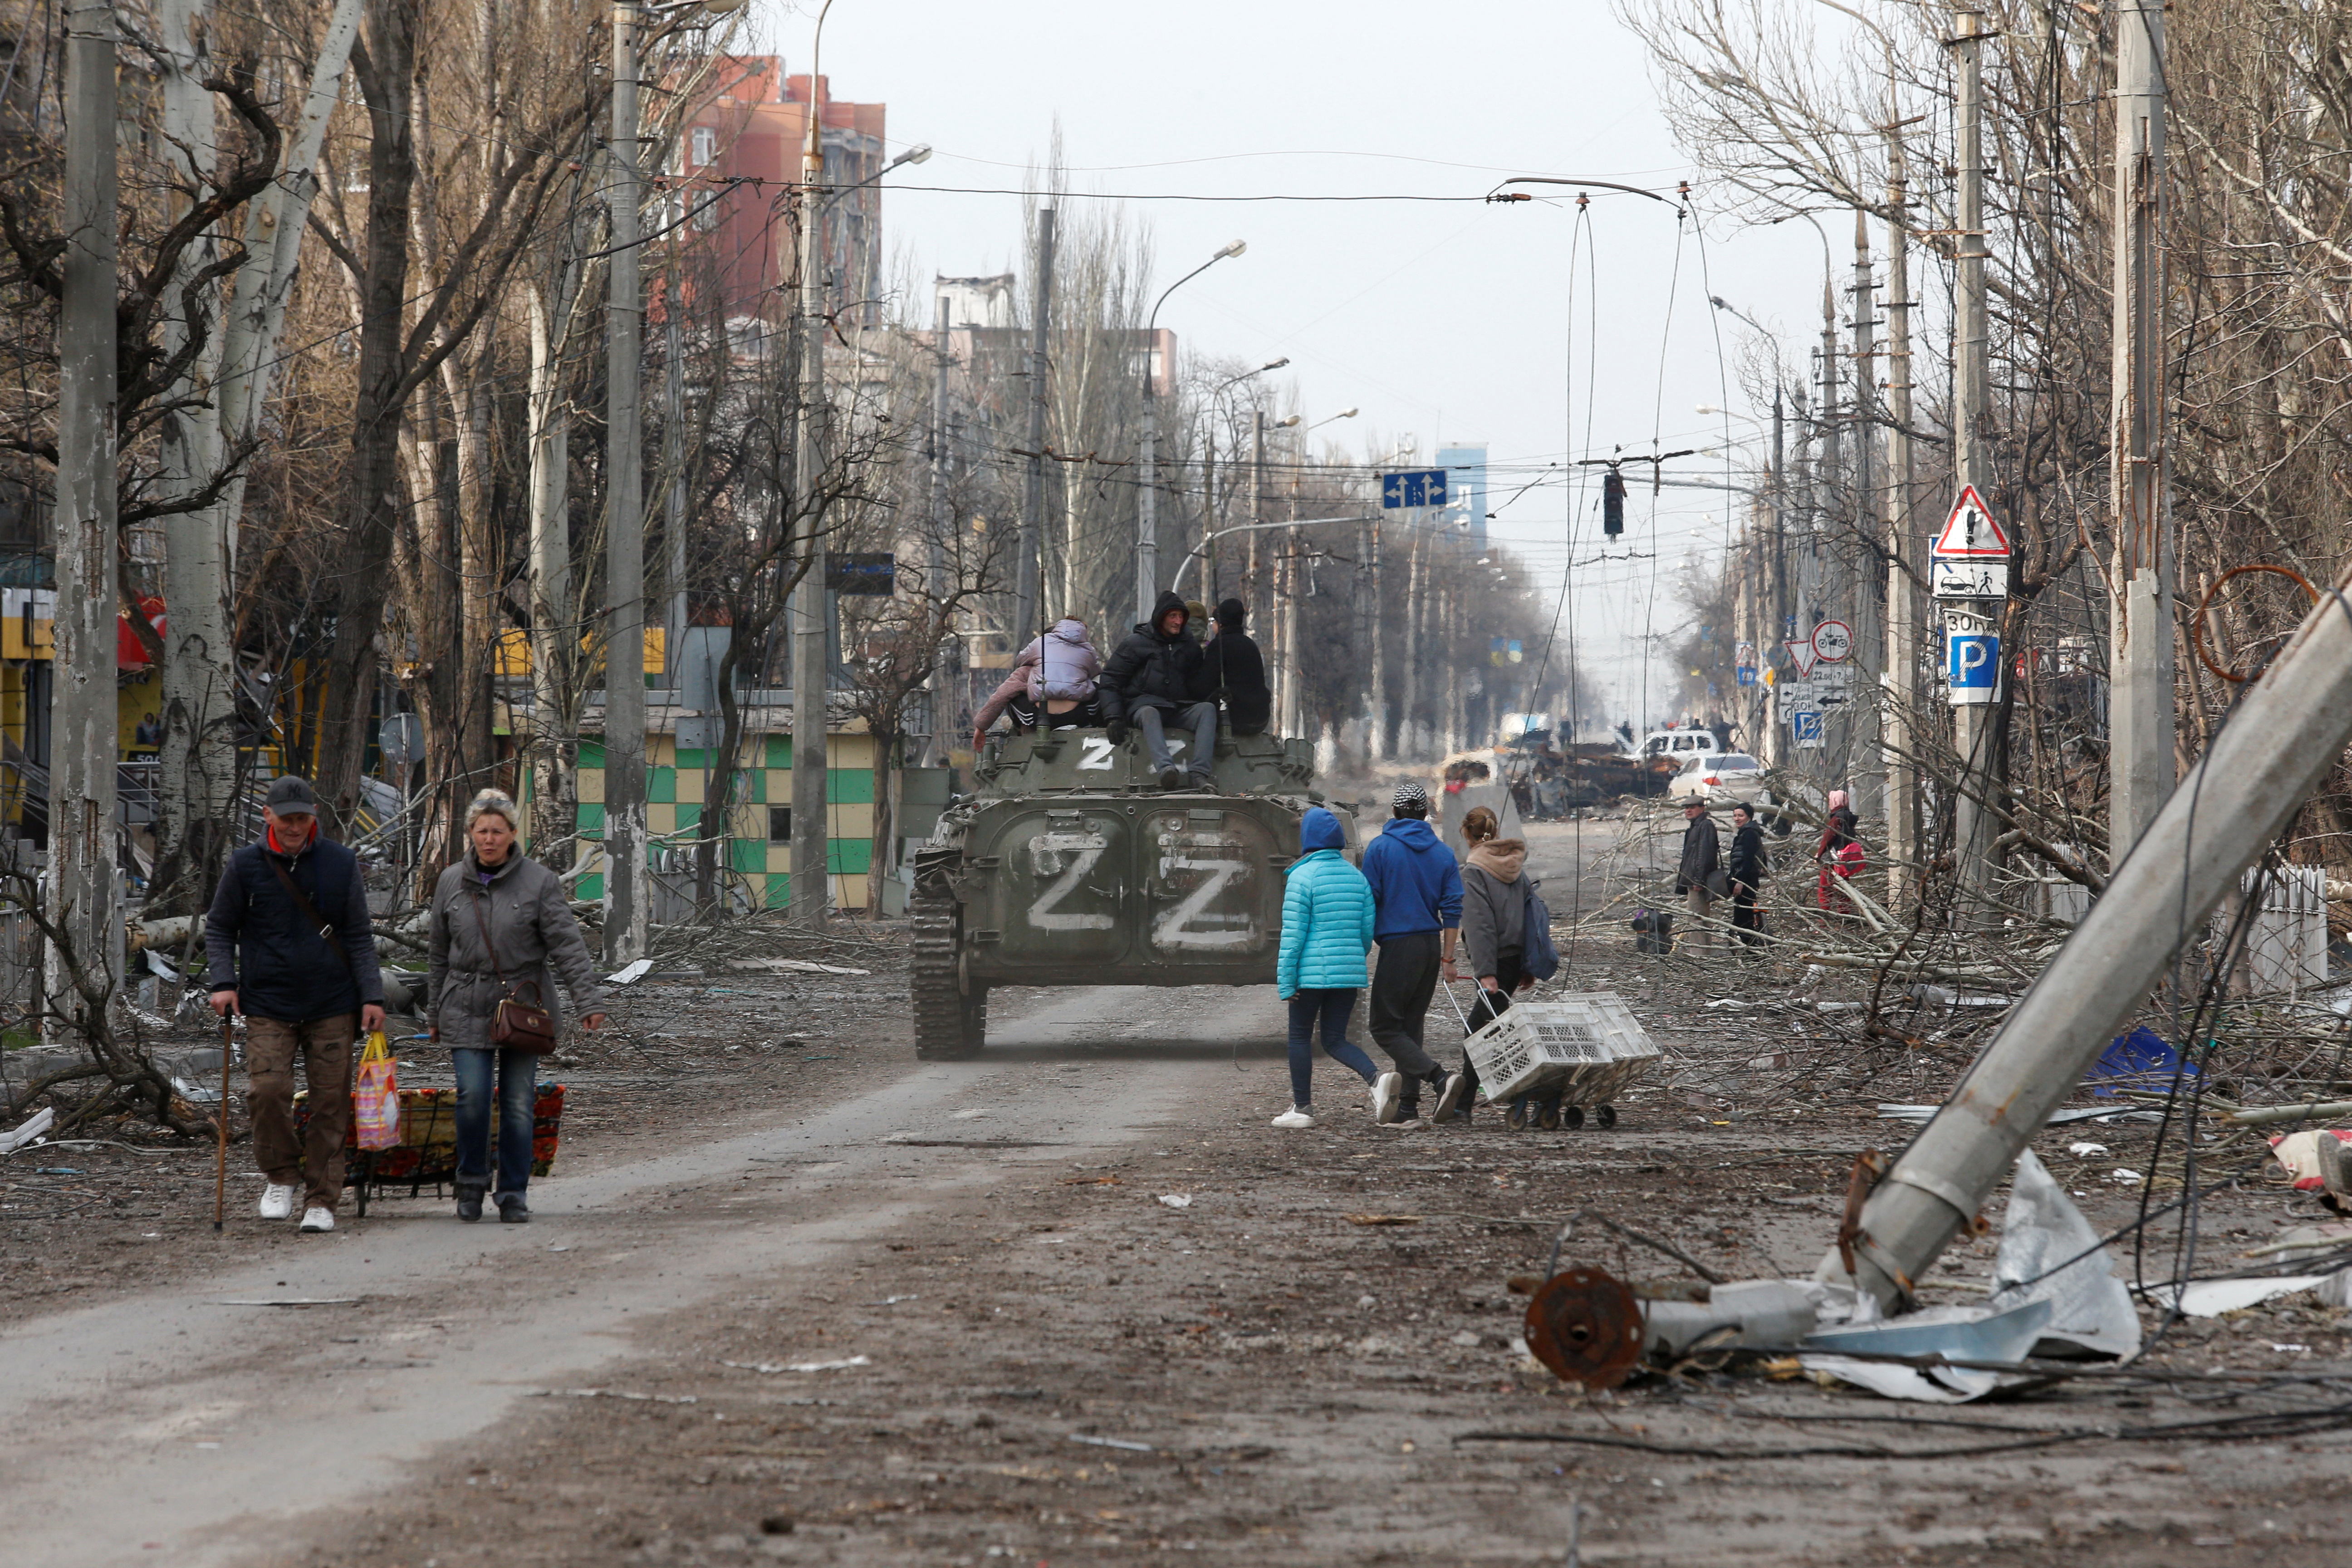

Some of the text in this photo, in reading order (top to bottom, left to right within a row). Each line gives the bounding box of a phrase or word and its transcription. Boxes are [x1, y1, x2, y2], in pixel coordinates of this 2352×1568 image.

[1077, 737, 1116, 770] Z
[1028, 832, 1114, 935] Z
[1152, 854, 1256, 948] Z
